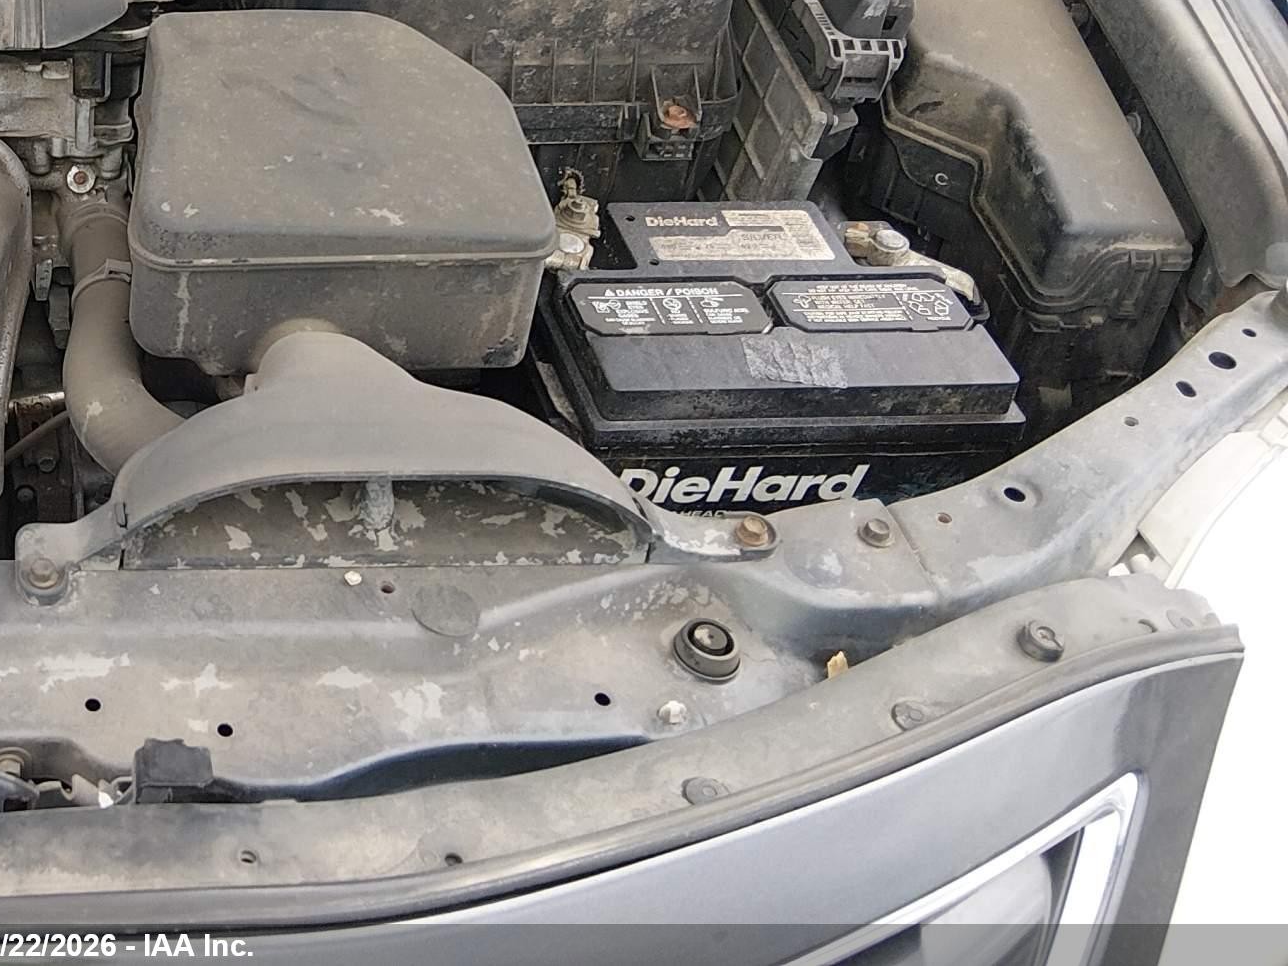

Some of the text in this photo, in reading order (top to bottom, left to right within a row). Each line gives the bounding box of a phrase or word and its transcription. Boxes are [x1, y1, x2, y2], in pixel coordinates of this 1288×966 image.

[645, 216, 719, 227] DieHard
[615, 288, 665, 297] DANGER
[674, 287, 719, 296] POISON
[619, 464, 870, 504] DieHard
